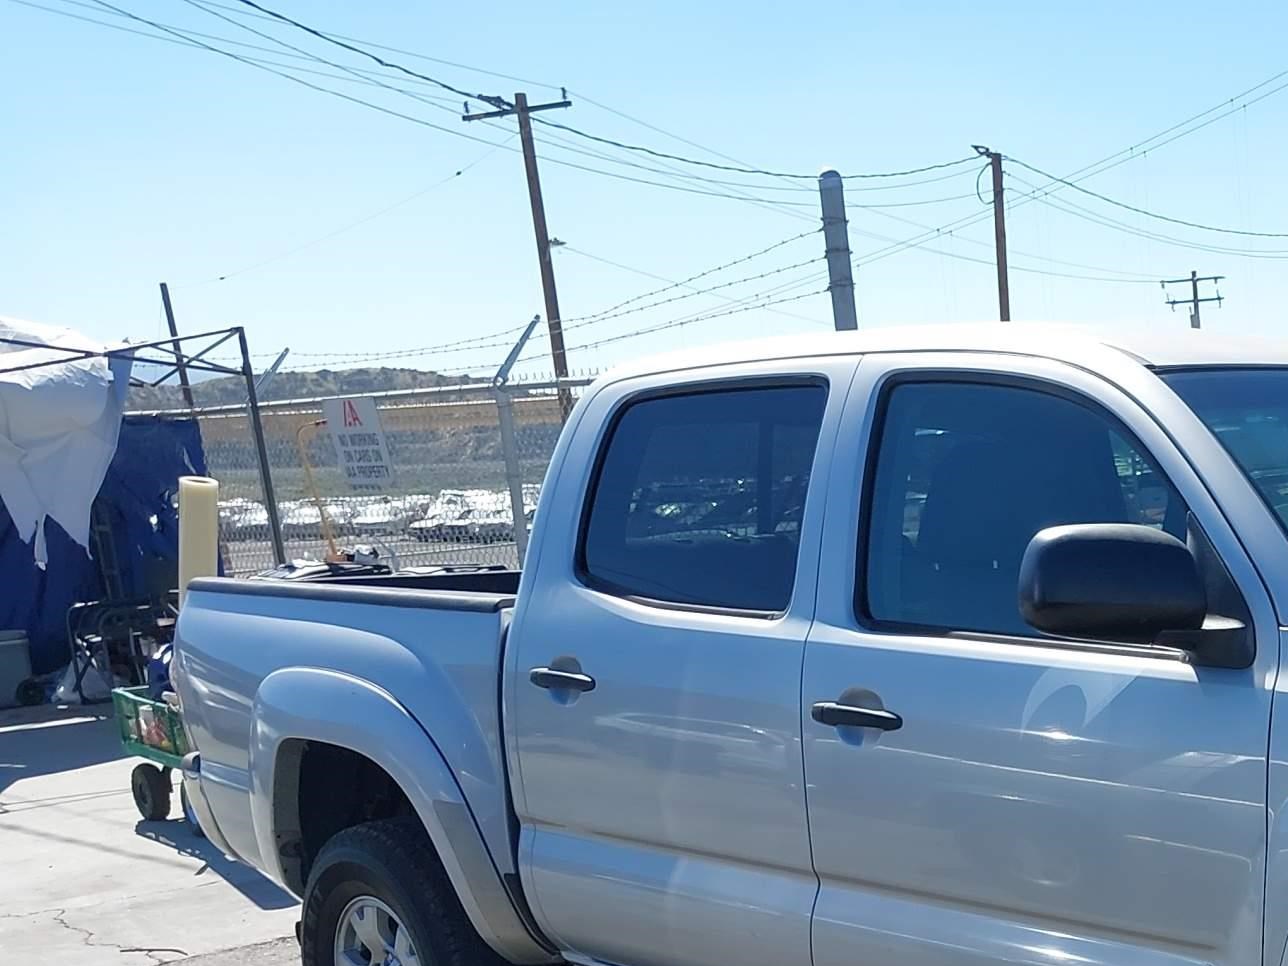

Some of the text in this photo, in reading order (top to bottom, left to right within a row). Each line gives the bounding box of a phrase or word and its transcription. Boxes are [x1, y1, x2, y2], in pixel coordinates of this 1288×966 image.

[338, 432, 380, 447] NO WORKING
[344, 449, 383, 463] ON CARS ON
[356, 465, 390, 479] PROPERTY
